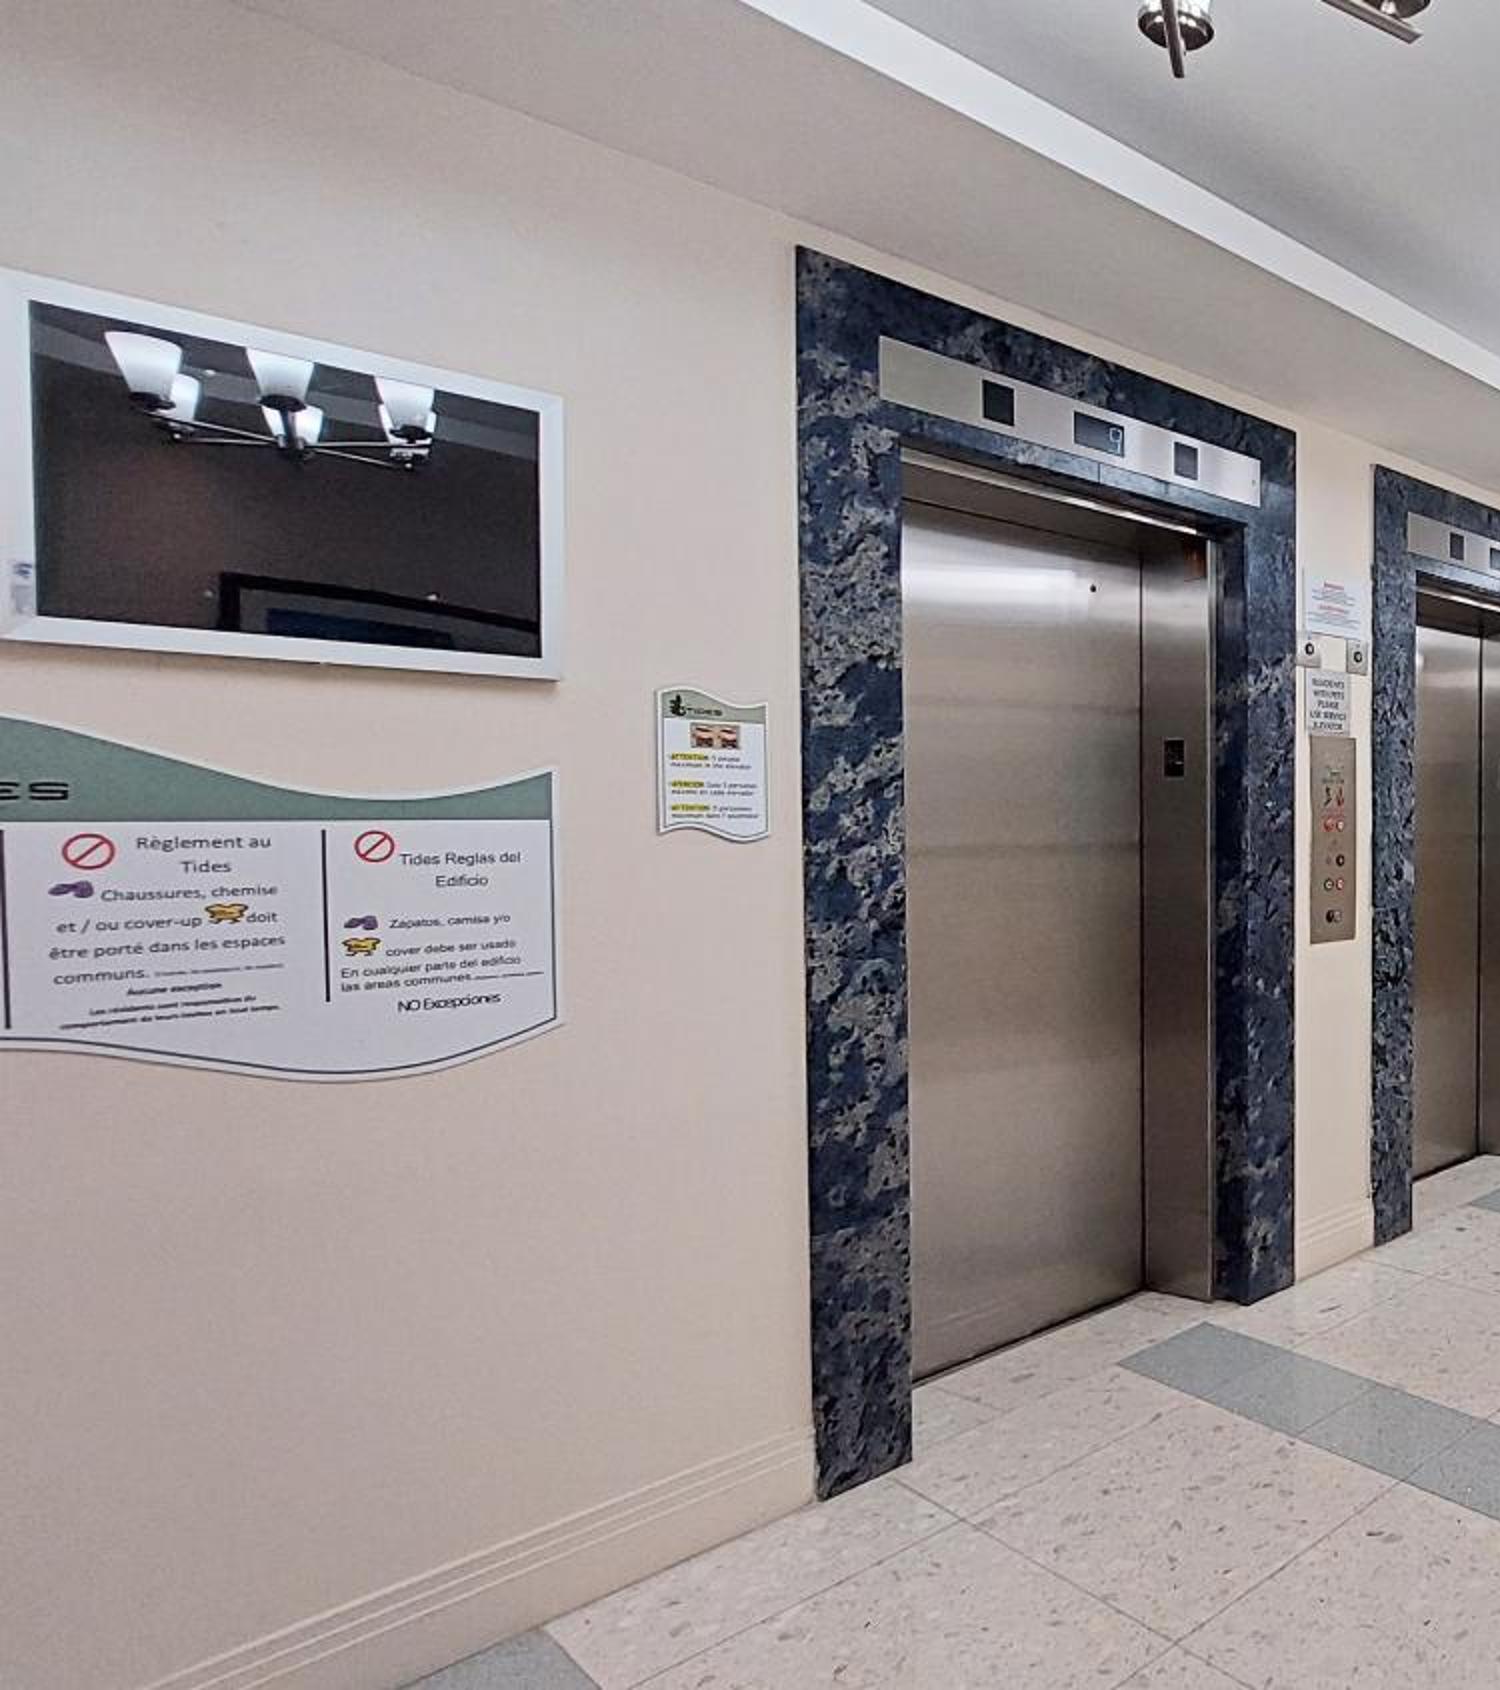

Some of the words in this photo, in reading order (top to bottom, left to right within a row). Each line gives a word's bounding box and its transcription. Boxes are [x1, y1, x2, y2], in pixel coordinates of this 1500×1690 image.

[1109, 427, 1122, 454] 9
[136, 836, 242, 852] Règlement
[249, 838, 272, 849] au
[180, 860, 232, 873] Tides
[400, 853, 440, 865] Tides
[445, 852, 496, 867] Reglas
[499, 851, 521, 863] del
[435, 874, 489, 887] Edificio
[100, 887, 206, 902] Chaussures,
[211, 884, 278, 896] chemise
[56, 922, 77, 933] et
[95, 922, 119, 932] ou
[124, 916, 202, 930] cover-up
[246, 912, 278, 924] doit
[448, 914, 490, 925] camisa
[49, 946, 88, 960] être
[94, 943, 143, 958] porté
[150, 940, 190, 953] dans
[194, 938, 218, 950] les
[222, 935, 286, 950] espaces
[385, 946, 421, 957] cover
[423, 943, 457, 954] debe
[458, 943, 477, 952] ser
[481, 939, 516, 949] usado
[341, 967, 359, 978] En
[363, 963, 421, 978] cualquier
[425, 961, 456, 973] parte
[459, 958, 479, 968] del
[481, 955, 521, 967] edificio
[341, 982, 360, 992] las
[397, 999, 421, 1012] NO
[423, 992, 502, 1010] Excepciones
